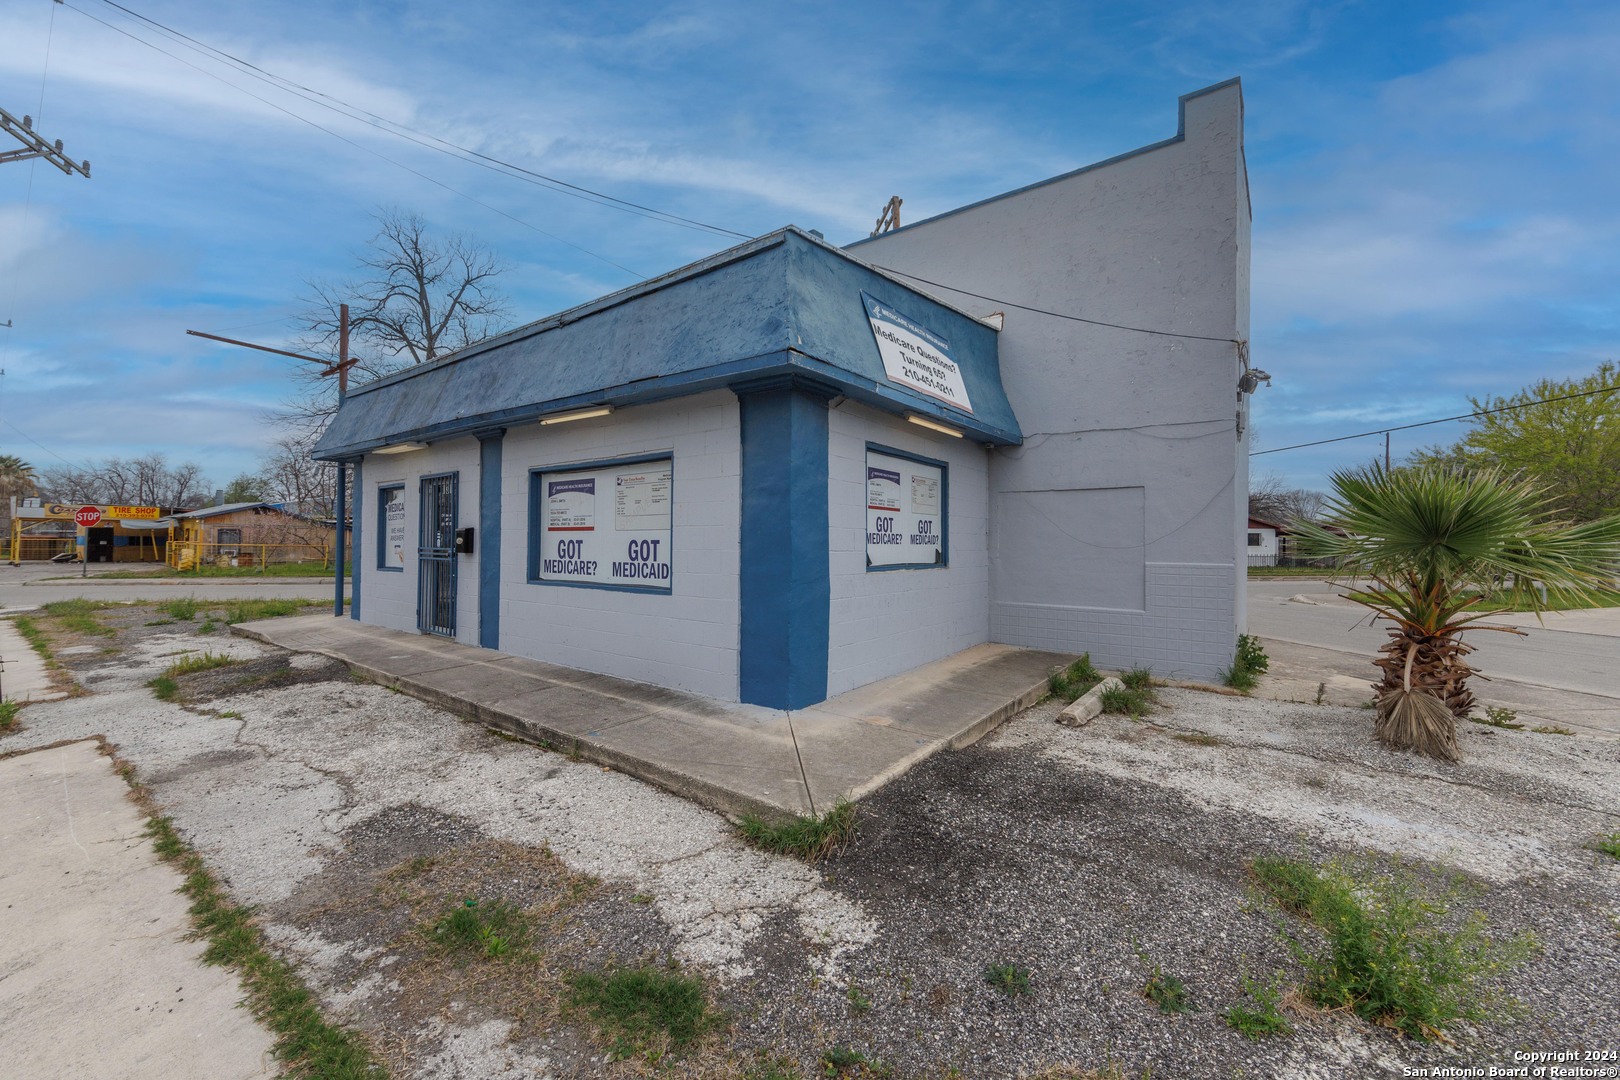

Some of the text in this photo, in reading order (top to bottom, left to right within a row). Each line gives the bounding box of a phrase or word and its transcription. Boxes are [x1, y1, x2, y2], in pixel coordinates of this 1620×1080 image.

[873, 323, 957, 374] Medicare Questions?
[899, 350, 947, 381] Turning 65?
[902, 366, 955, 398] 210-451-0211
[76, 512, 100, 521] STOP
[113, 506, 132, 514] TIRE
[876, 516, 894, 533] GOT
[917, 519, 933, 534] GOT
[867, 532, 903, 545] MEDICARE?
[910, 534, 939, 545] MEDICAID?
[557, 539, 584, 560] GOT
[628, 539, 660, 562] GOT
[543, 559, 598, 576] MEDICARE?
[612, 561, 670, 580] MEDICAID
